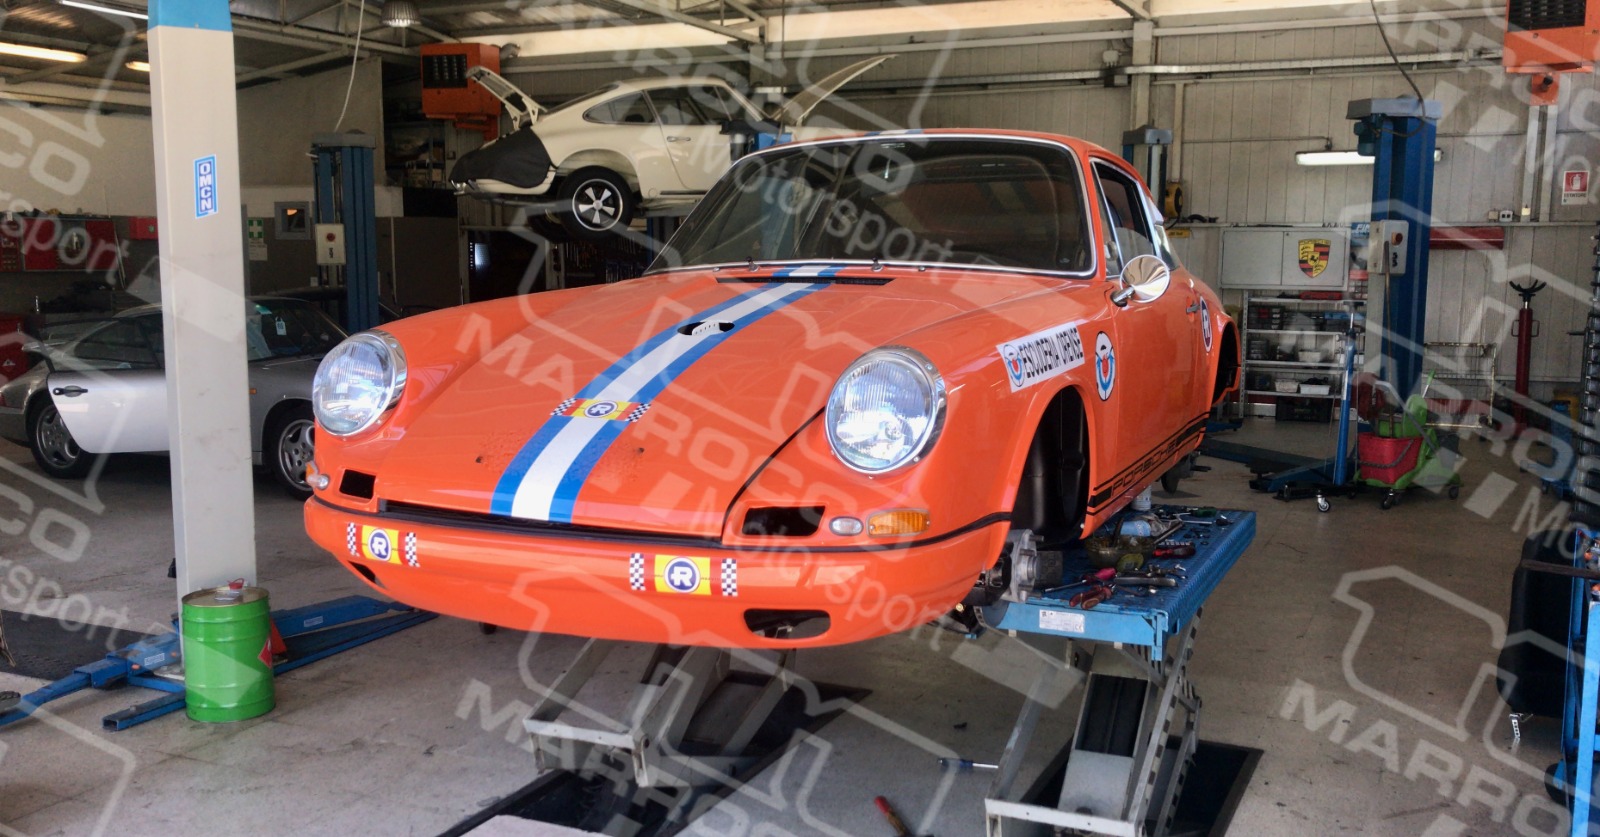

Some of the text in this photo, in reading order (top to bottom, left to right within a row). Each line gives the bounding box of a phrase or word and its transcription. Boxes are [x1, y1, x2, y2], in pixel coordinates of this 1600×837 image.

[199, 162, 213, 212] OMCN
[590, 404, 611, 414] R
[1110, 440, 1177, 498] PORSCHE
[371, 536, 388, 556] R
[671, 566, 693, 586] R
